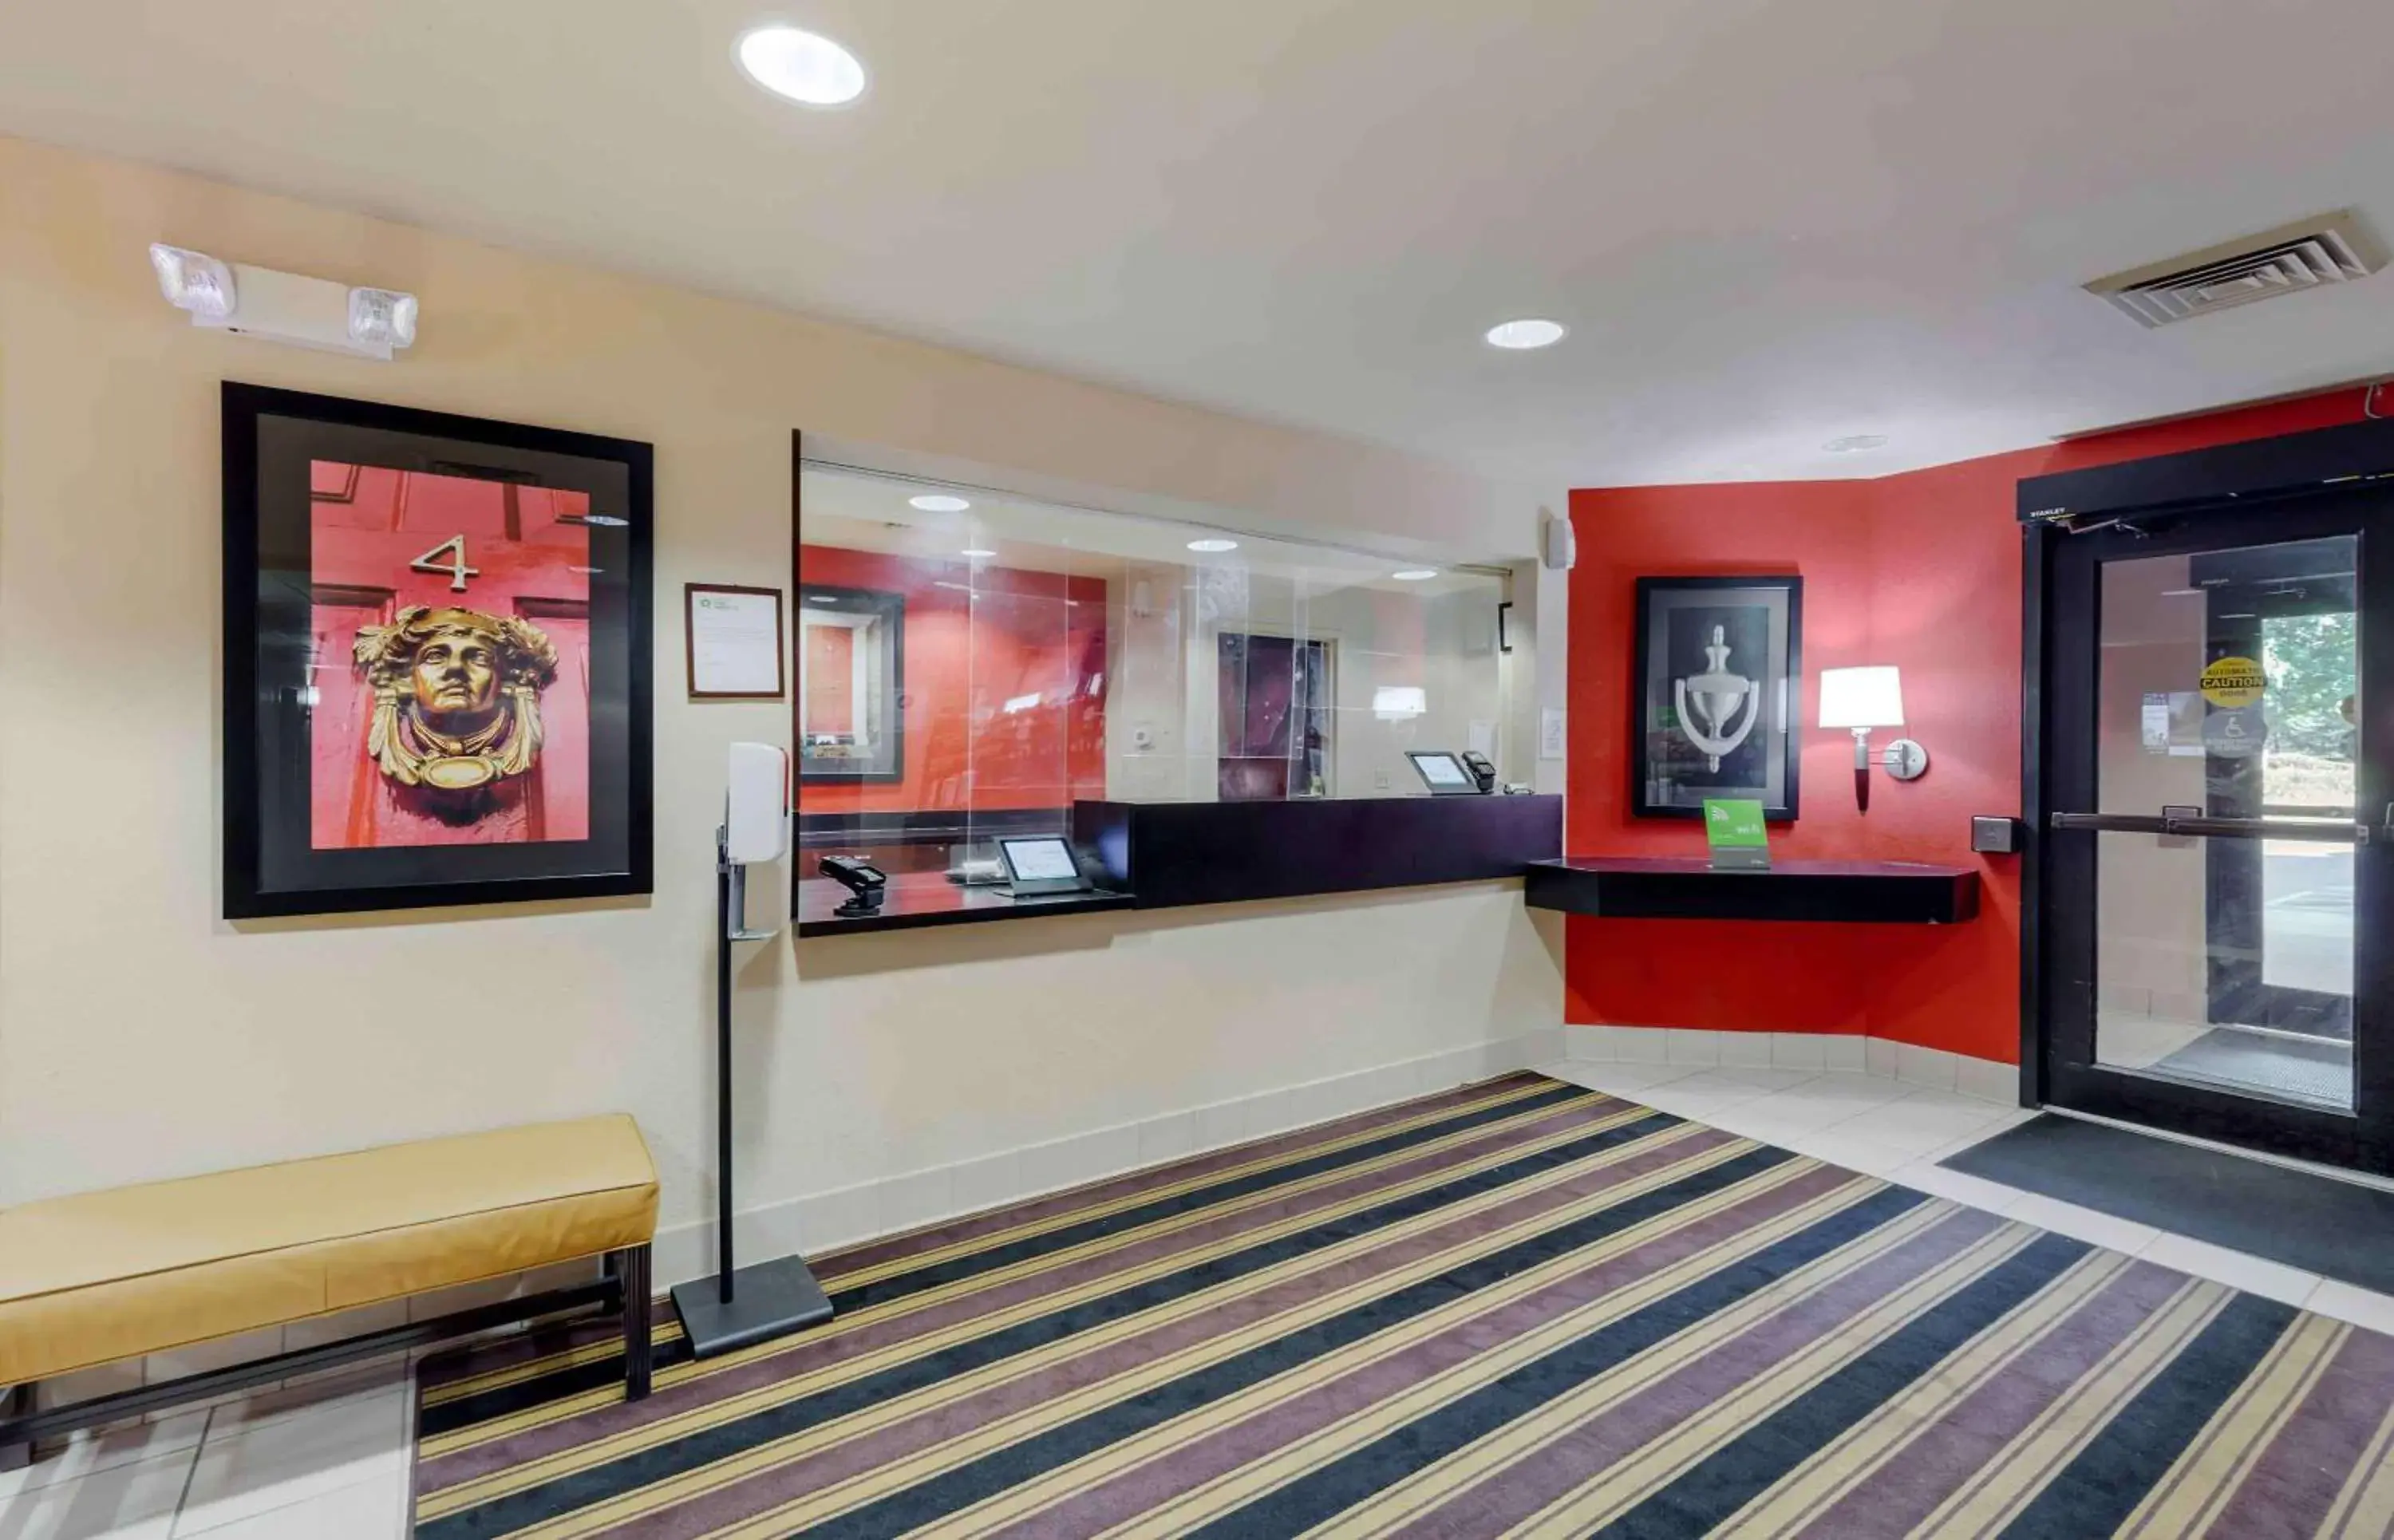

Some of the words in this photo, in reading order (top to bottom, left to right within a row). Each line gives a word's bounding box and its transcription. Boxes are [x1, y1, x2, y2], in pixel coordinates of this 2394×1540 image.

[2029, 507, 2066, 518] STANLEY
[409, 534, 479, 590] 4
[2202, 677, 2263, 688] CAUTION
